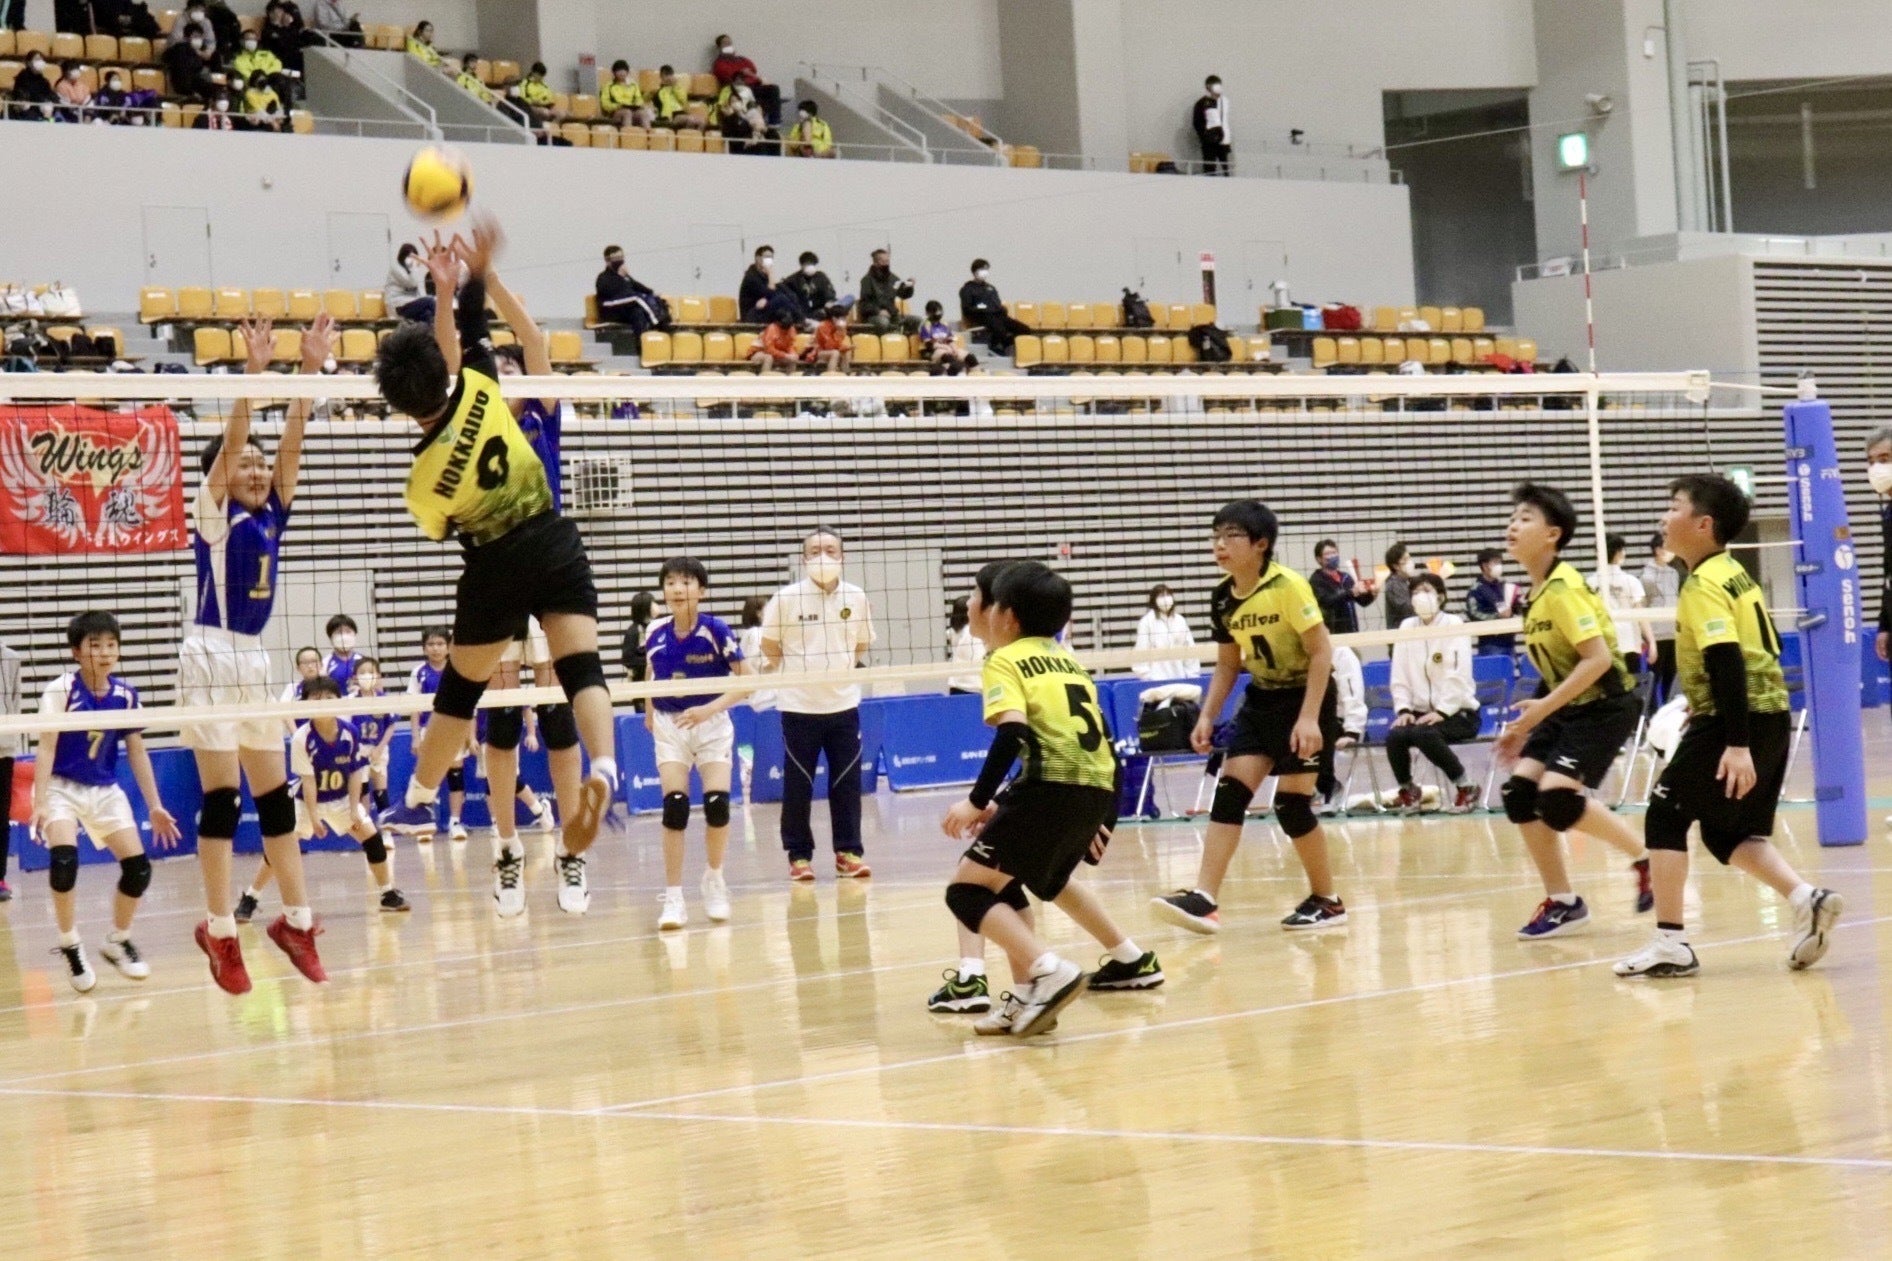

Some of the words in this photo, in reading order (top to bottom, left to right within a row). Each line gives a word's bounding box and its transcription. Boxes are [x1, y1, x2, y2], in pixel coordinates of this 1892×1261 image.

[31, 431, 143, 484] Wings
[433, 390, 490, 499] HOKKAIDO
[249, 554, 271, 599] 1
[1841, 579, 1856, 644] Senoh
[1016, 655, 1092, 680] HOKKA
[361, 721, 379, 740] 12
[1064, 683, 1102, 752] 5
[87, 729, 105, 760] 7
[318, 769, 344, 792] 10
